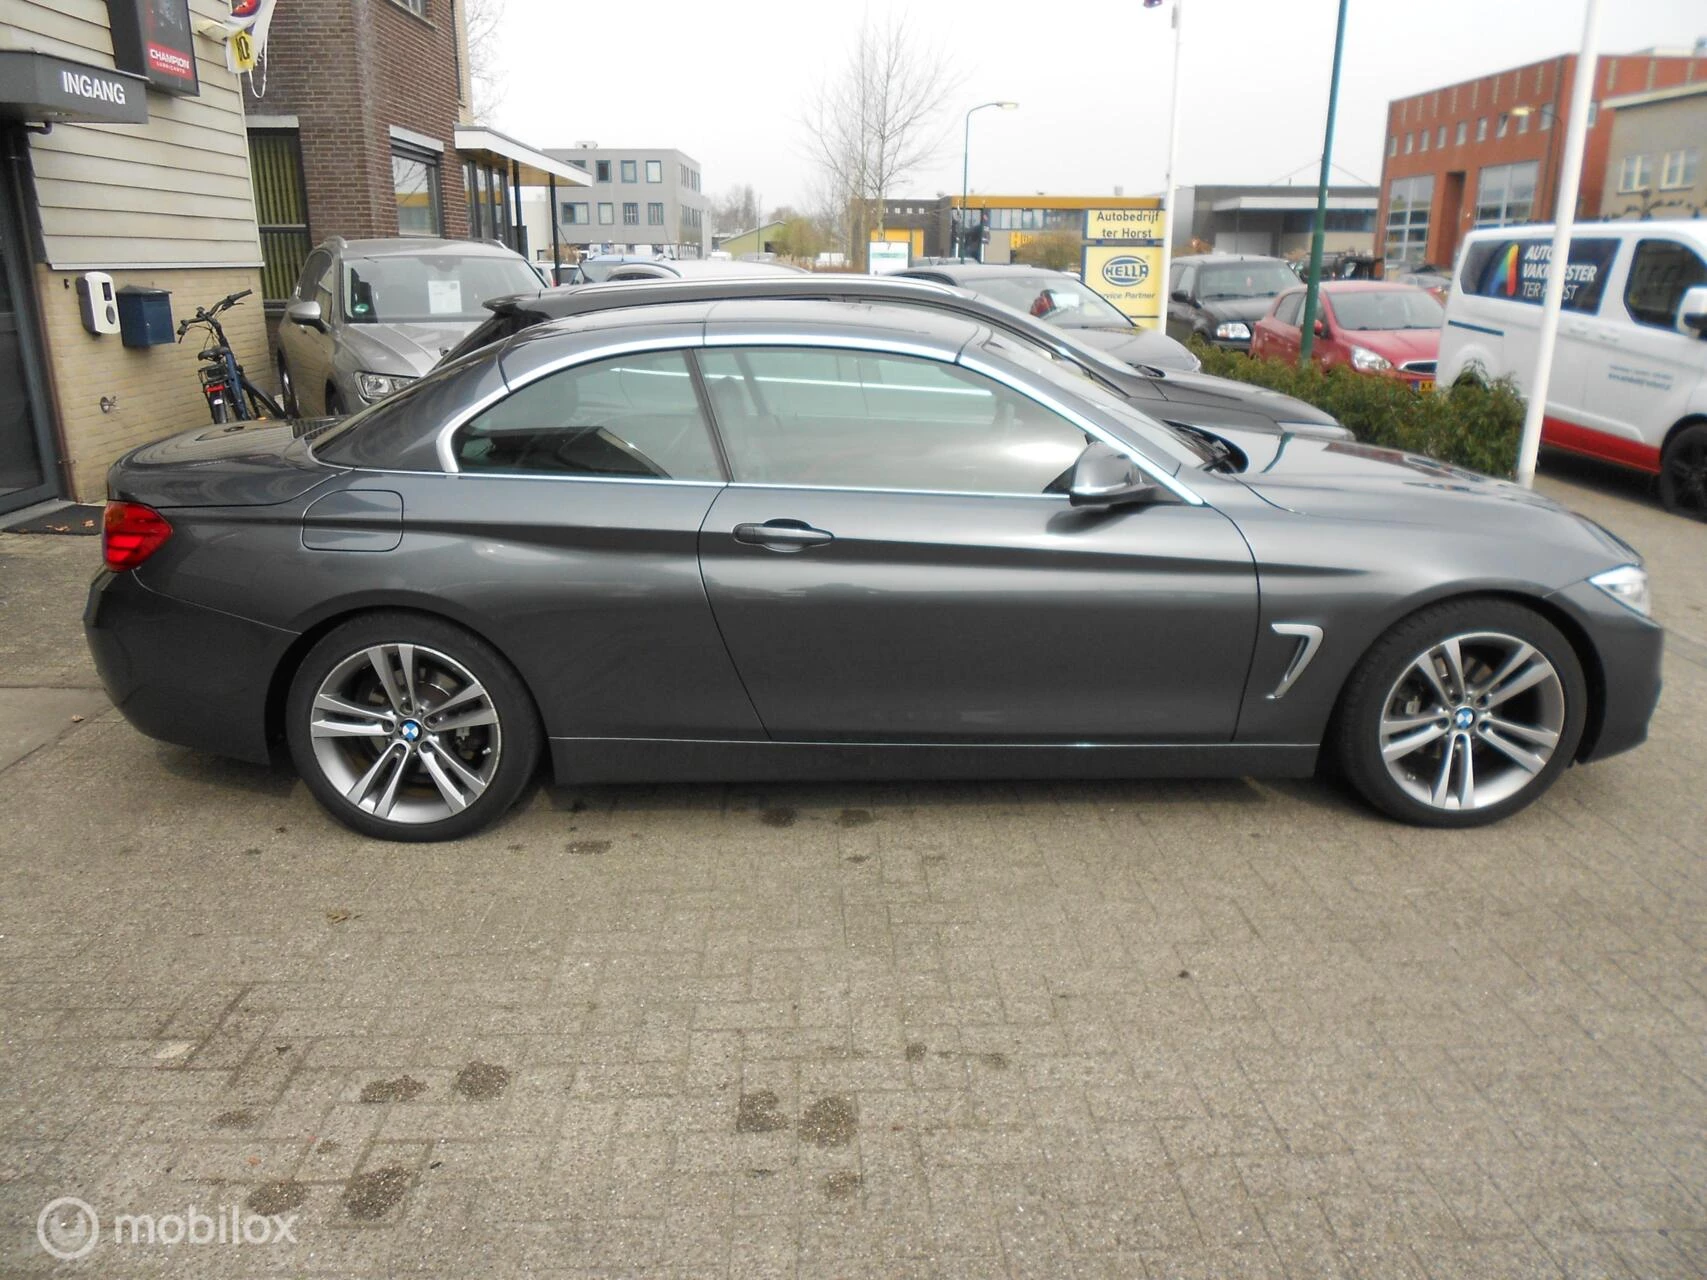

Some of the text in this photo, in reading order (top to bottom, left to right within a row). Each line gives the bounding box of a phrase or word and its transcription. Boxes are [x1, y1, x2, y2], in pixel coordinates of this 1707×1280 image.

[150, 49, 190, 69] CHAMPION
[62, 71, 126, 105] INGANG
[1097, 210, 1159, 223] Autobedrijf
[1102, 228, 1152, 238] ter Horst
[1105, 264, 1149, 278] HELLA
[1523, 282, 1541, 297] TER
